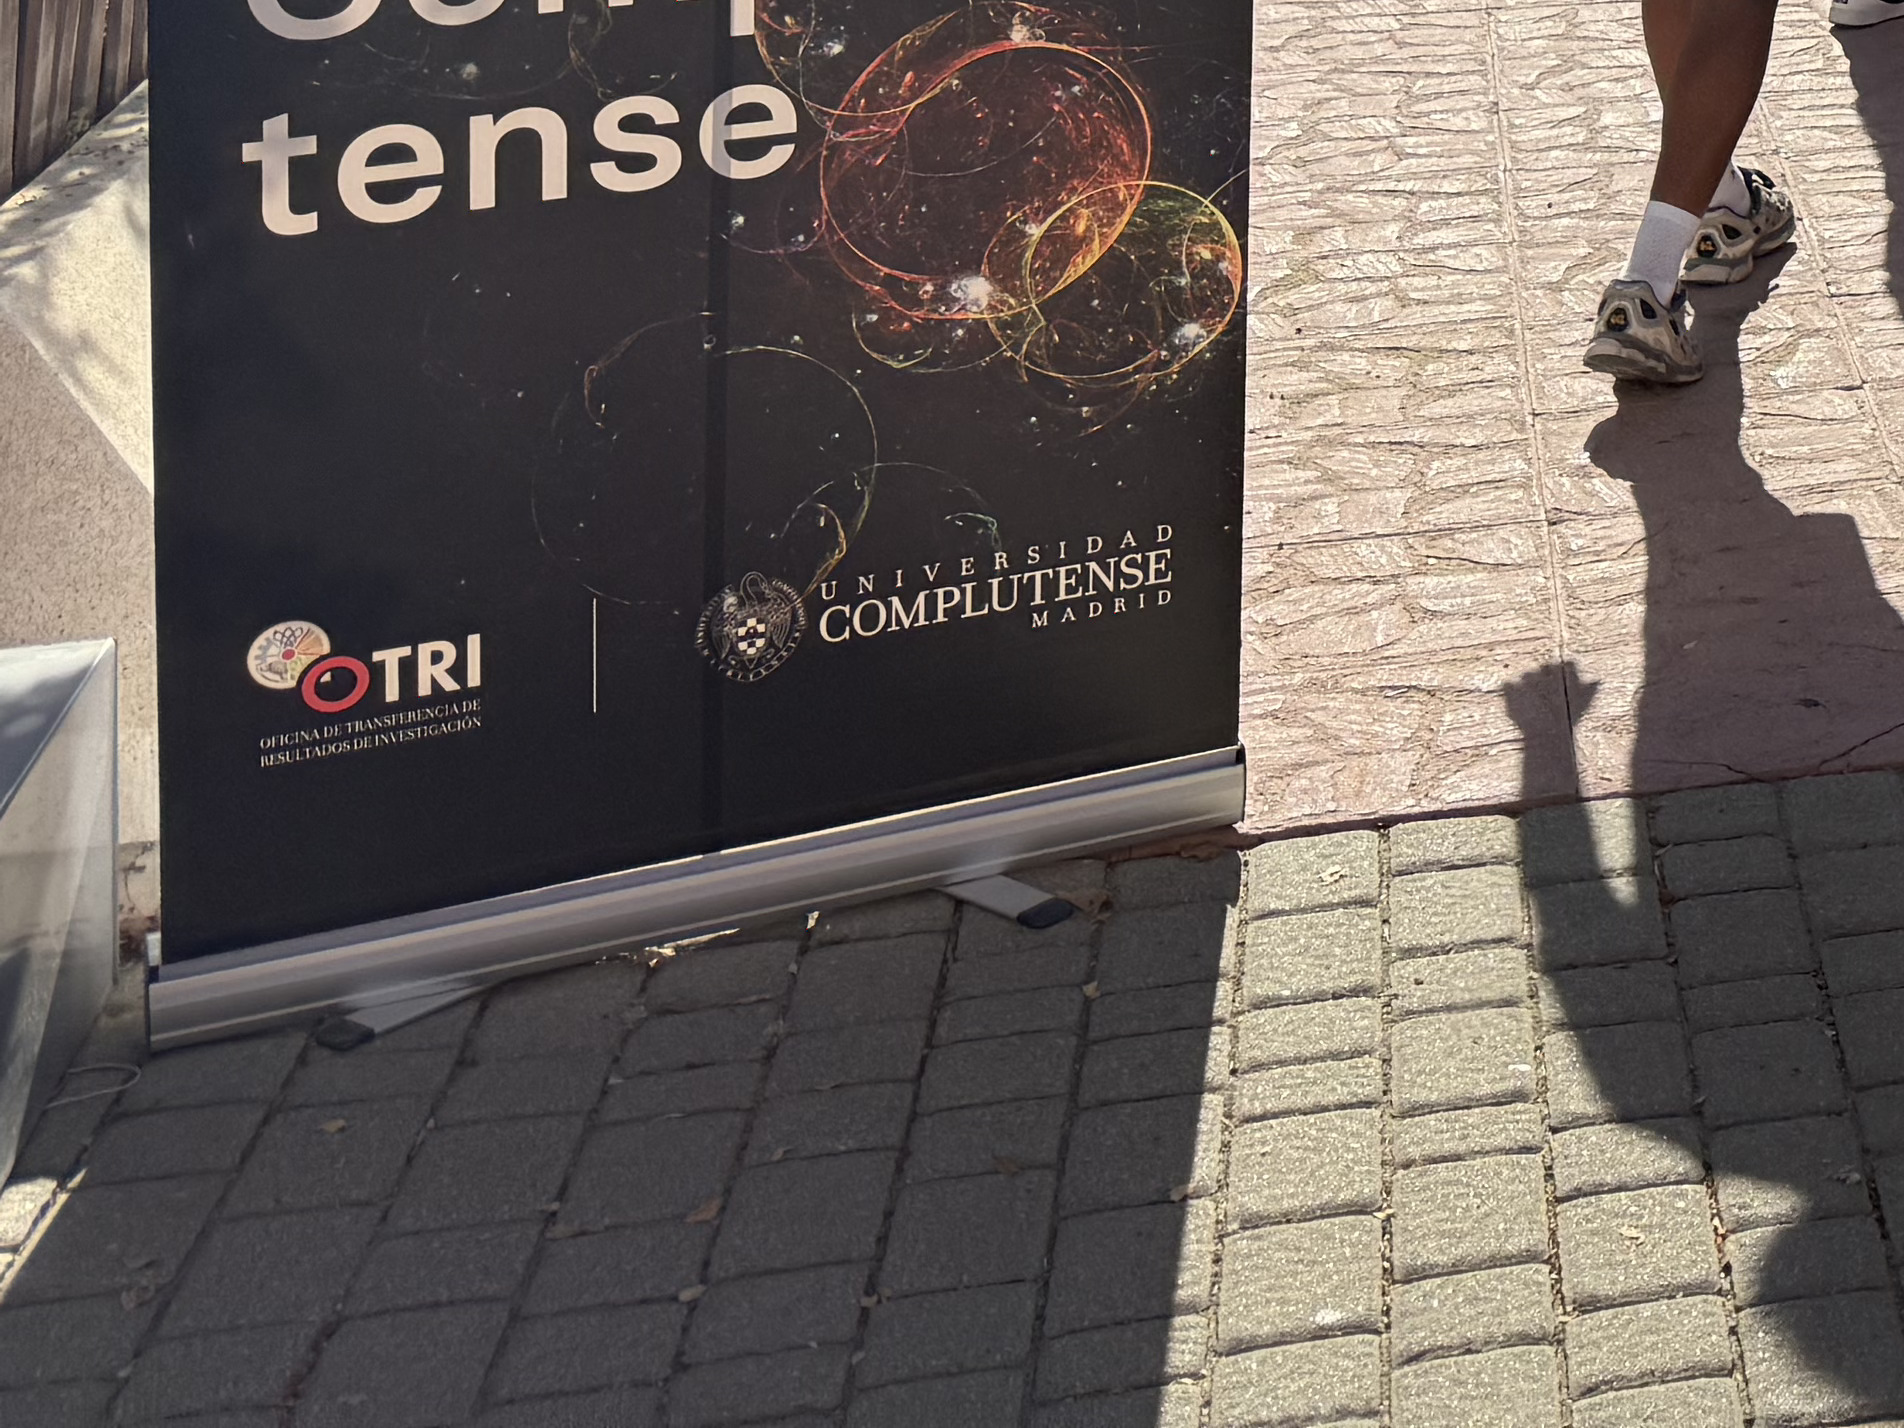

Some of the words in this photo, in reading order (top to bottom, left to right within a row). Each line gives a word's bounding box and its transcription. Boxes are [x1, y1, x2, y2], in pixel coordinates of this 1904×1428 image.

[240, 82, 799, 237] tense
[818, 548, 1173, 643] COMPLUTENSE
[819, 524, 1173, 600] UNIVERSIDAD
[1031, 589, 1173, 628] MADRID
[301, 633, 481, 713] OTRI
[259, 728, 320, 750] OFICINA
[323, 724, 343, 738] DE
[344, 704, 460, 733] TRANSFERENCIA
[462, 698, 482, 713] DE
[259, 739, 351, 767] RESULTADOS
[353, 737, 373, 751] DE
[374, 715, 482, 747] INVESTIGACIÓN
